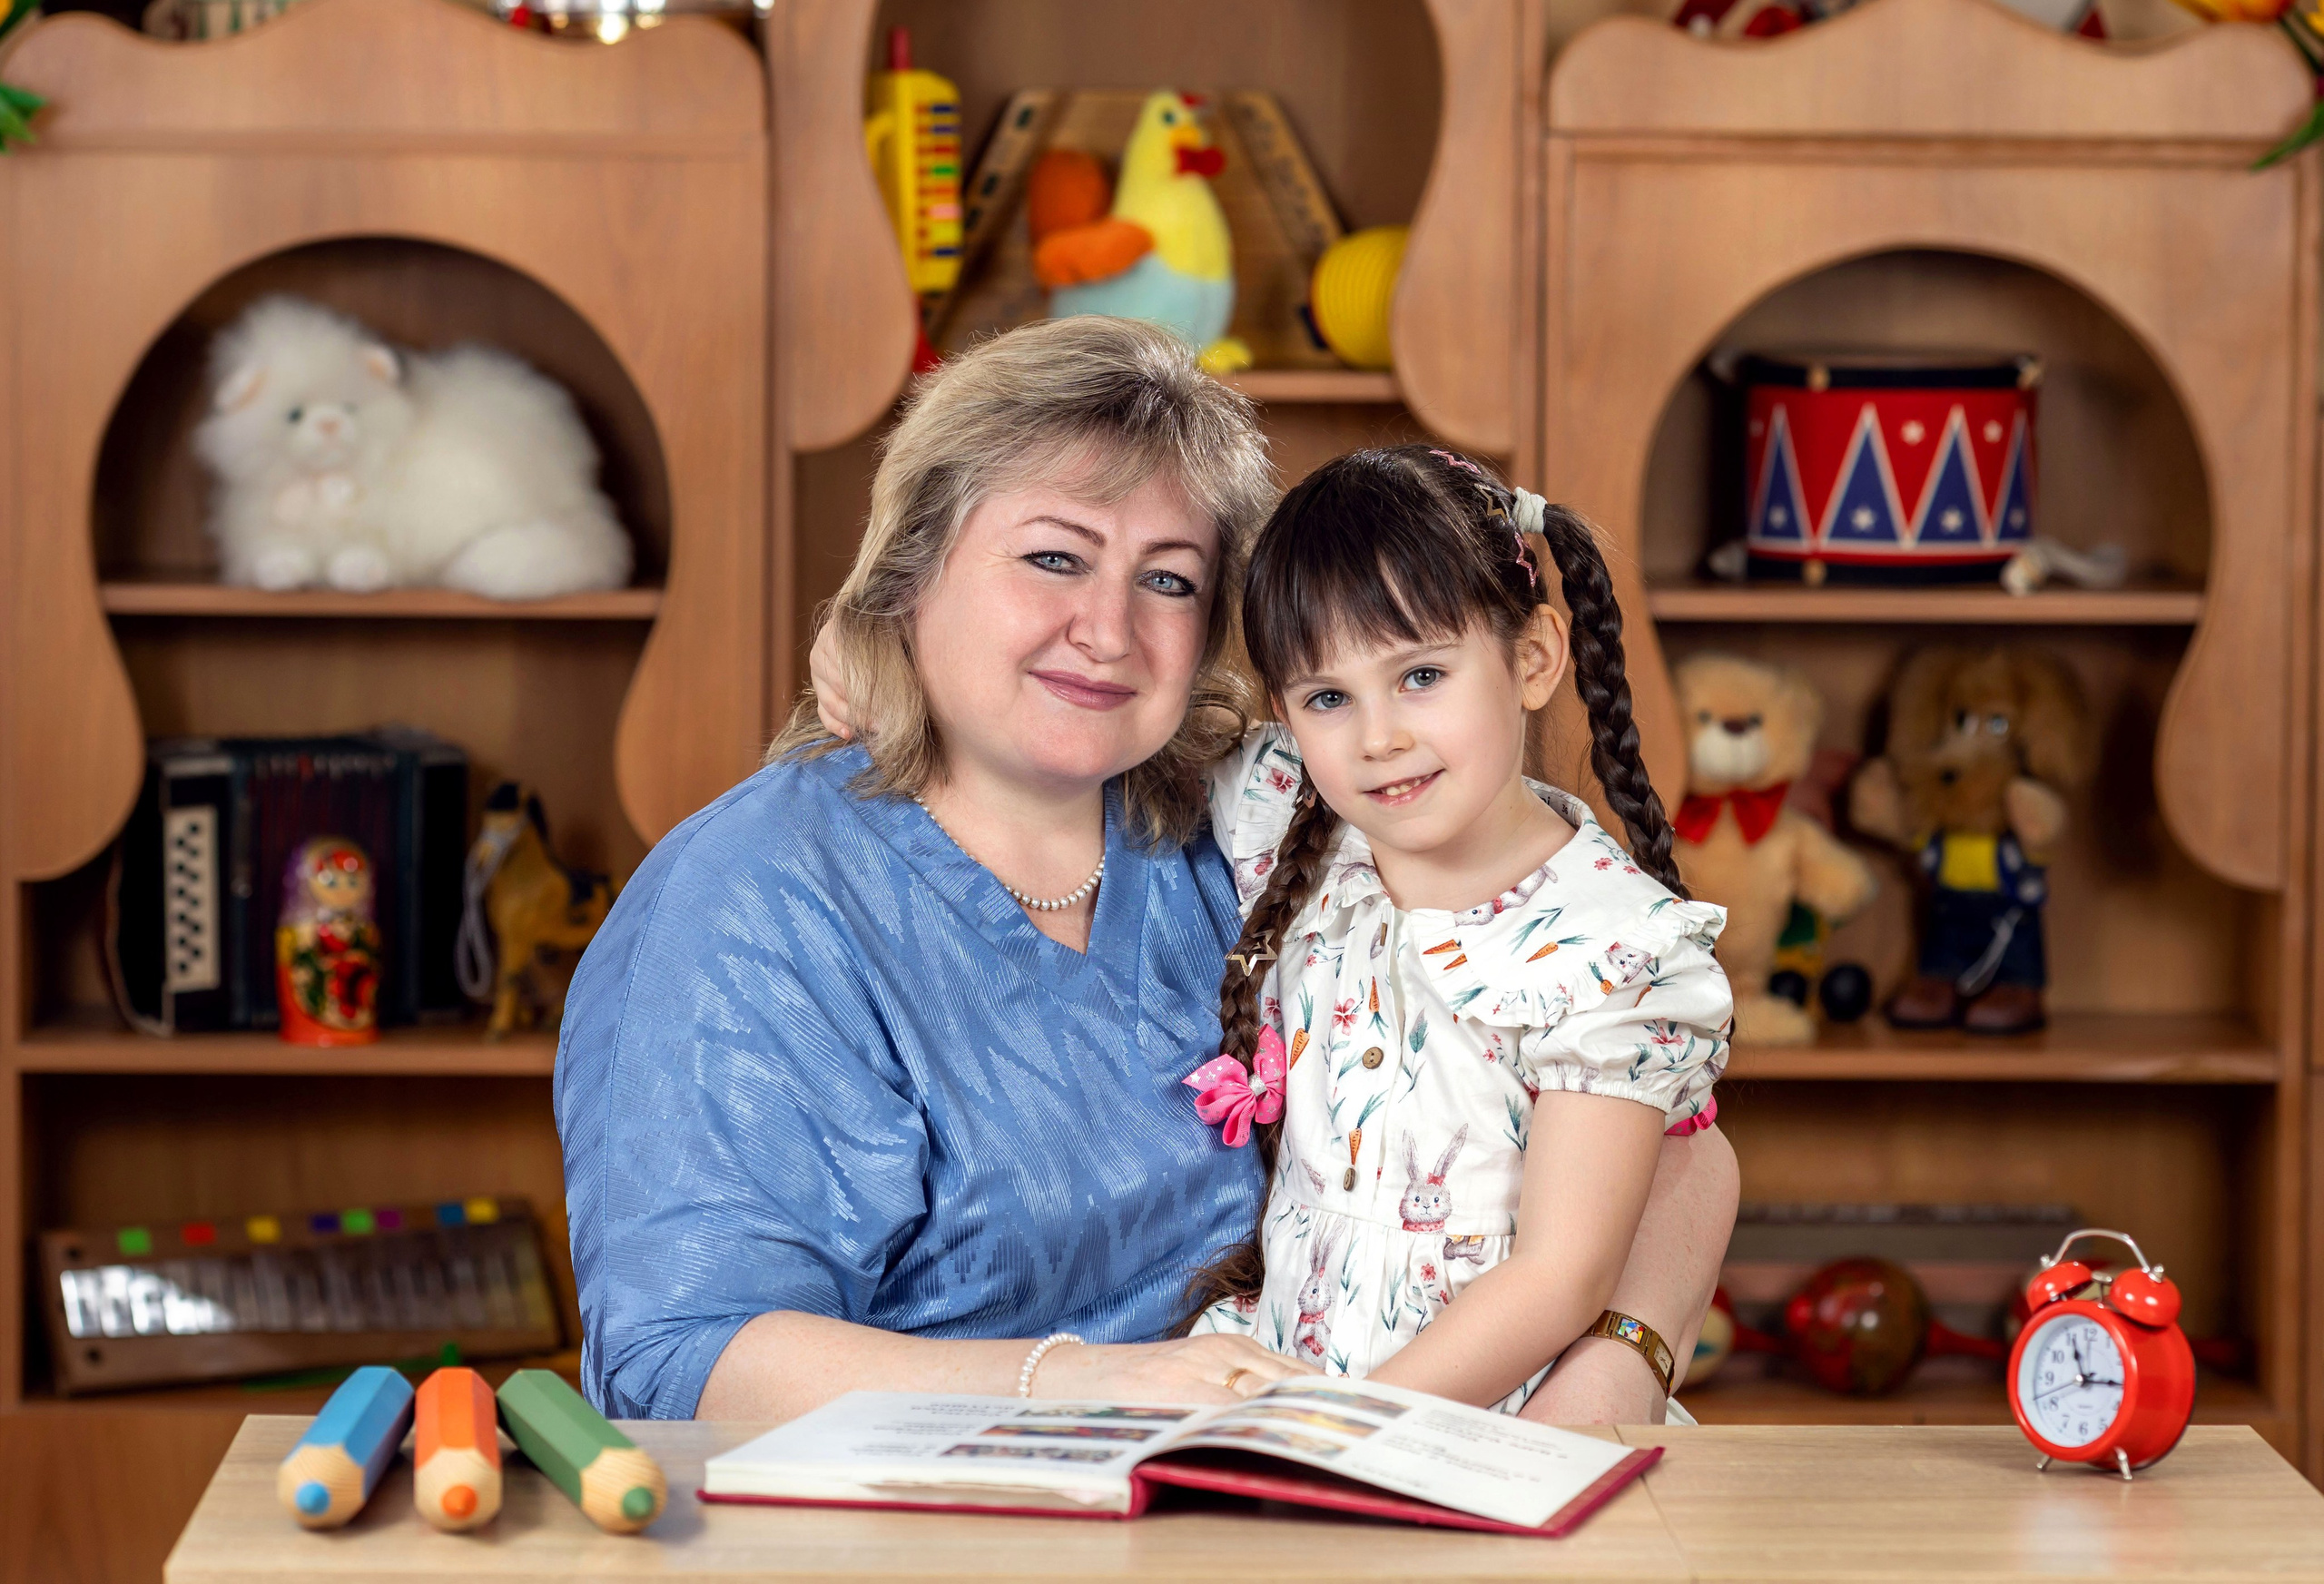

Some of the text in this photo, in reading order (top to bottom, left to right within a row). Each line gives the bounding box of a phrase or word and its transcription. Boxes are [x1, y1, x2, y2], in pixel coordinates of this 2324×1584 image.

[2066, 1333, 2077, 1346] 11
[2083, 1328, 2097, 1342] 12
[2052, 1350, 2065, 1363] 10
[2045, 1372, 2054, 1386] 9
[2050, 1397, 2059, 1412] 8
[2062, 1414, 2070, 1429] 7
[2079, 1422, 2089, 1435] 6
[2097, 1418, 2108, 1432] 5
